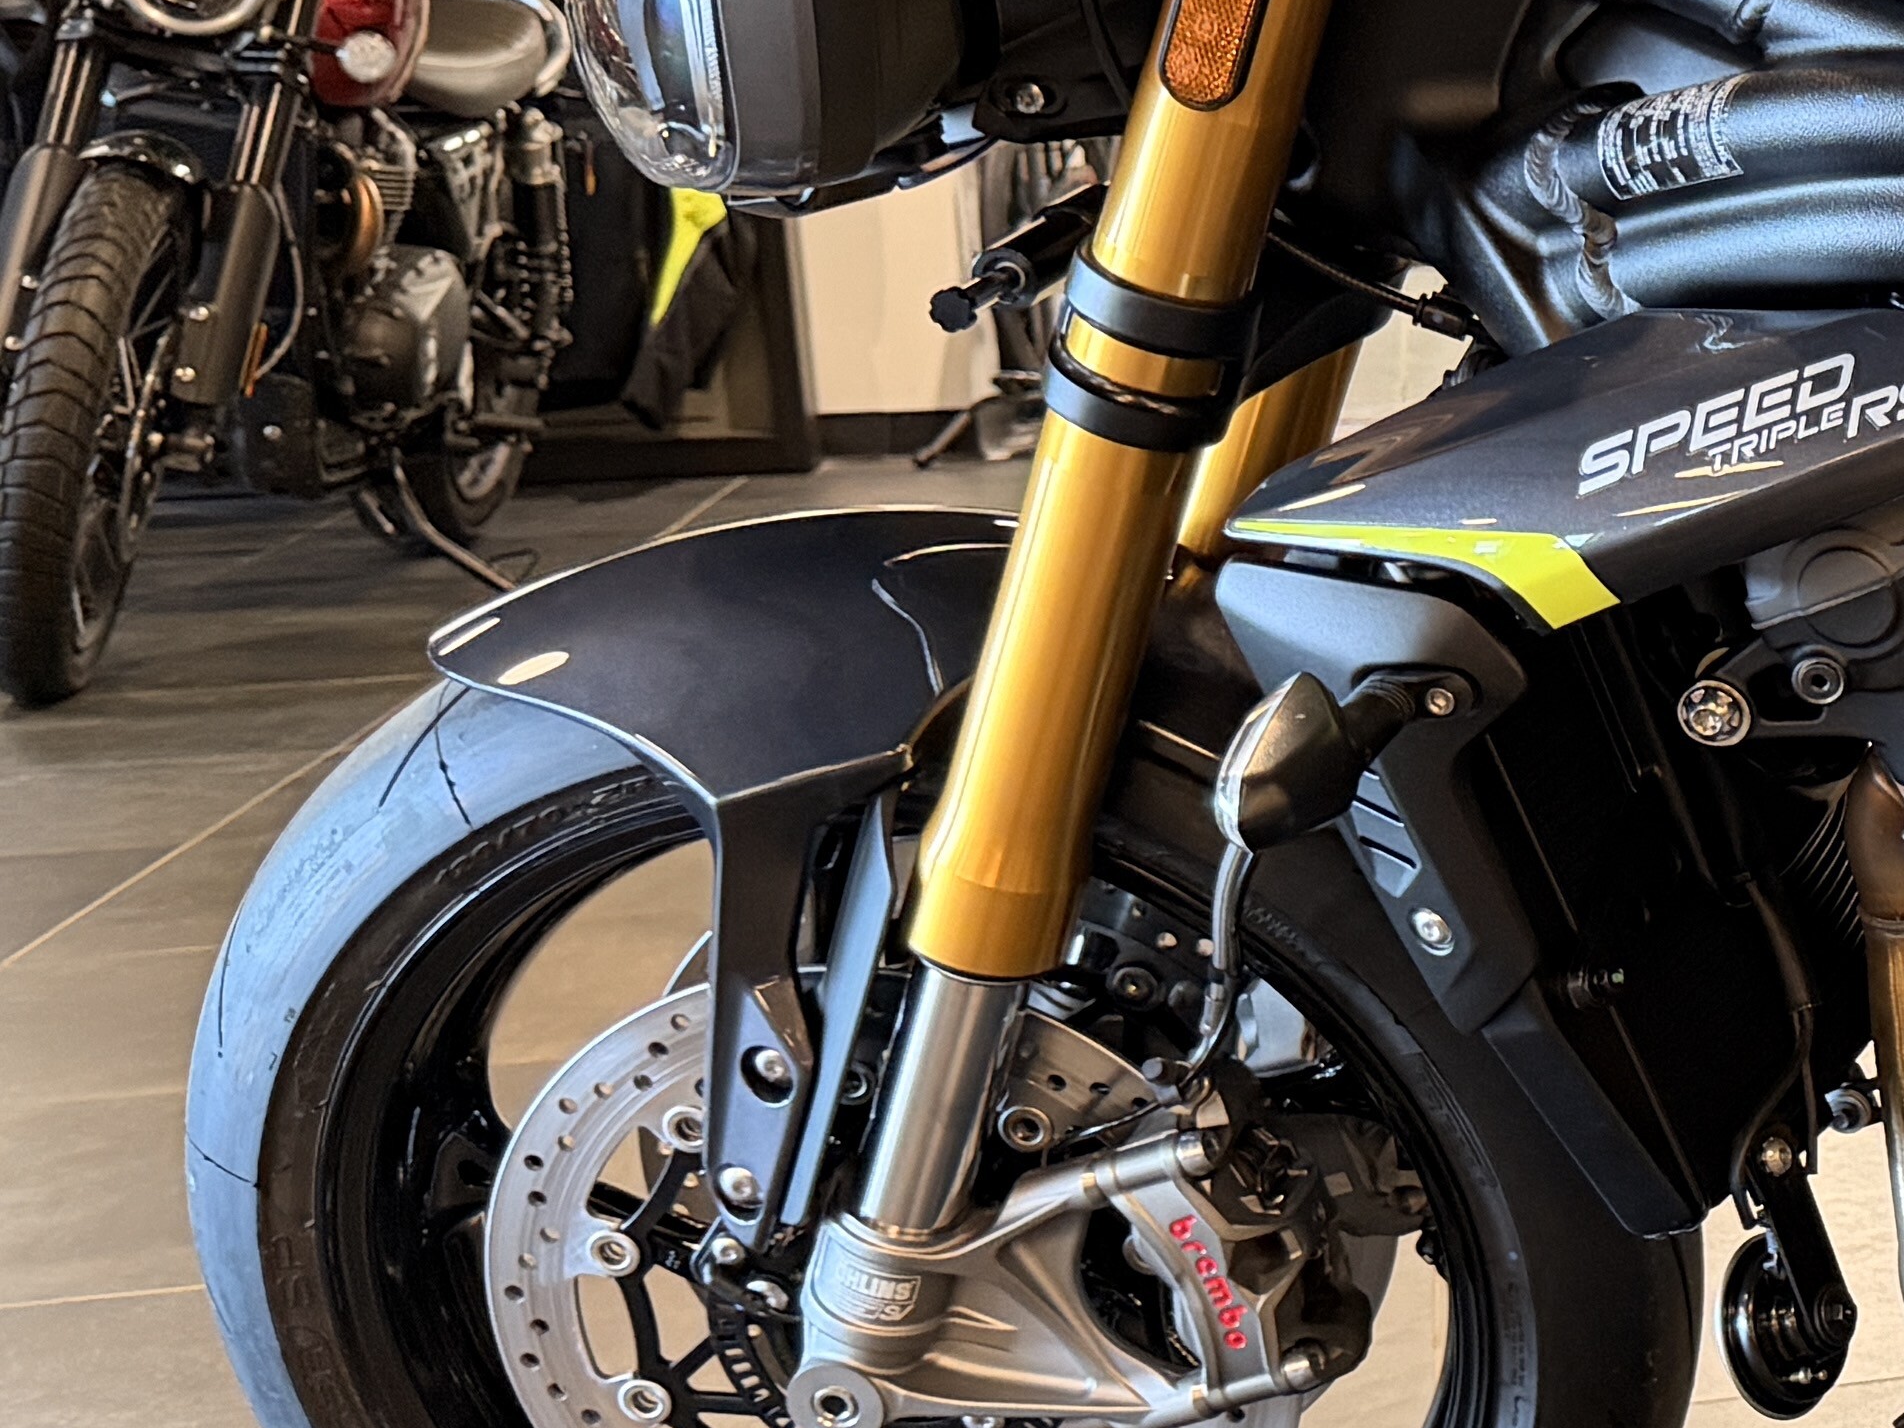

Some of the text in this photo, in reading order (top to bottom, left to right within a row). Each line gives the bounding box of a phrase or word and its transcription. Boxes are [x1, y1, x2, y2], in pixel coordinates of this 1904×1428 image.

[1577, 354, 1855, 497] SPEED
[1708, 403, 1846, 472] TRIPLE
[1170, 1215, 1247, 1349] brembo
